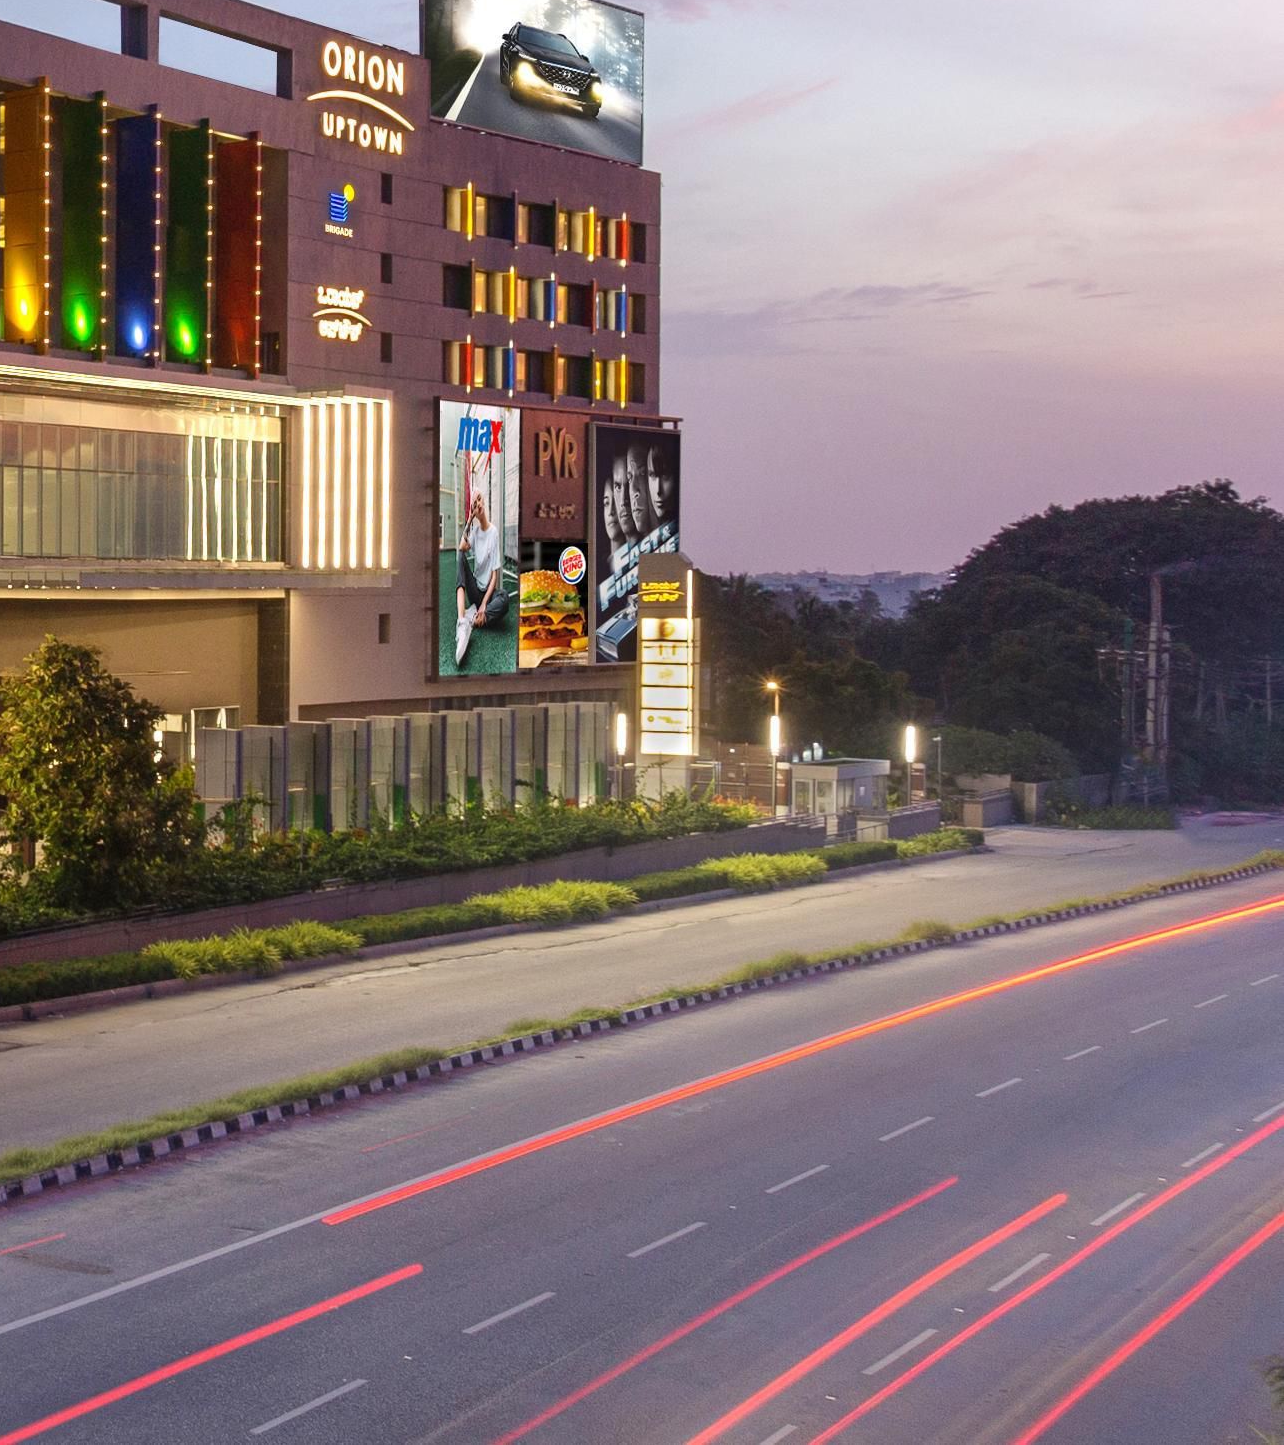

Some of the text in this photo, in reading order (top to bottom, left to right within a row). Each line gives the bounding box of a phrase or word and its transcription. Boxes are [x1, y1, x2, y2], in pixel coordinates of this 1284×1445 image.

[323, 40, 404, 96] ORION
[322, 111, 403, 156] UPTOWN
[325, 223, 354, 238] BRIGADE
[458, 417, 503, 474] max
[538, 426, 578, 481] PVR
[563, 560, 583, 575] KING
[614, 527, 661, 576] FAST
